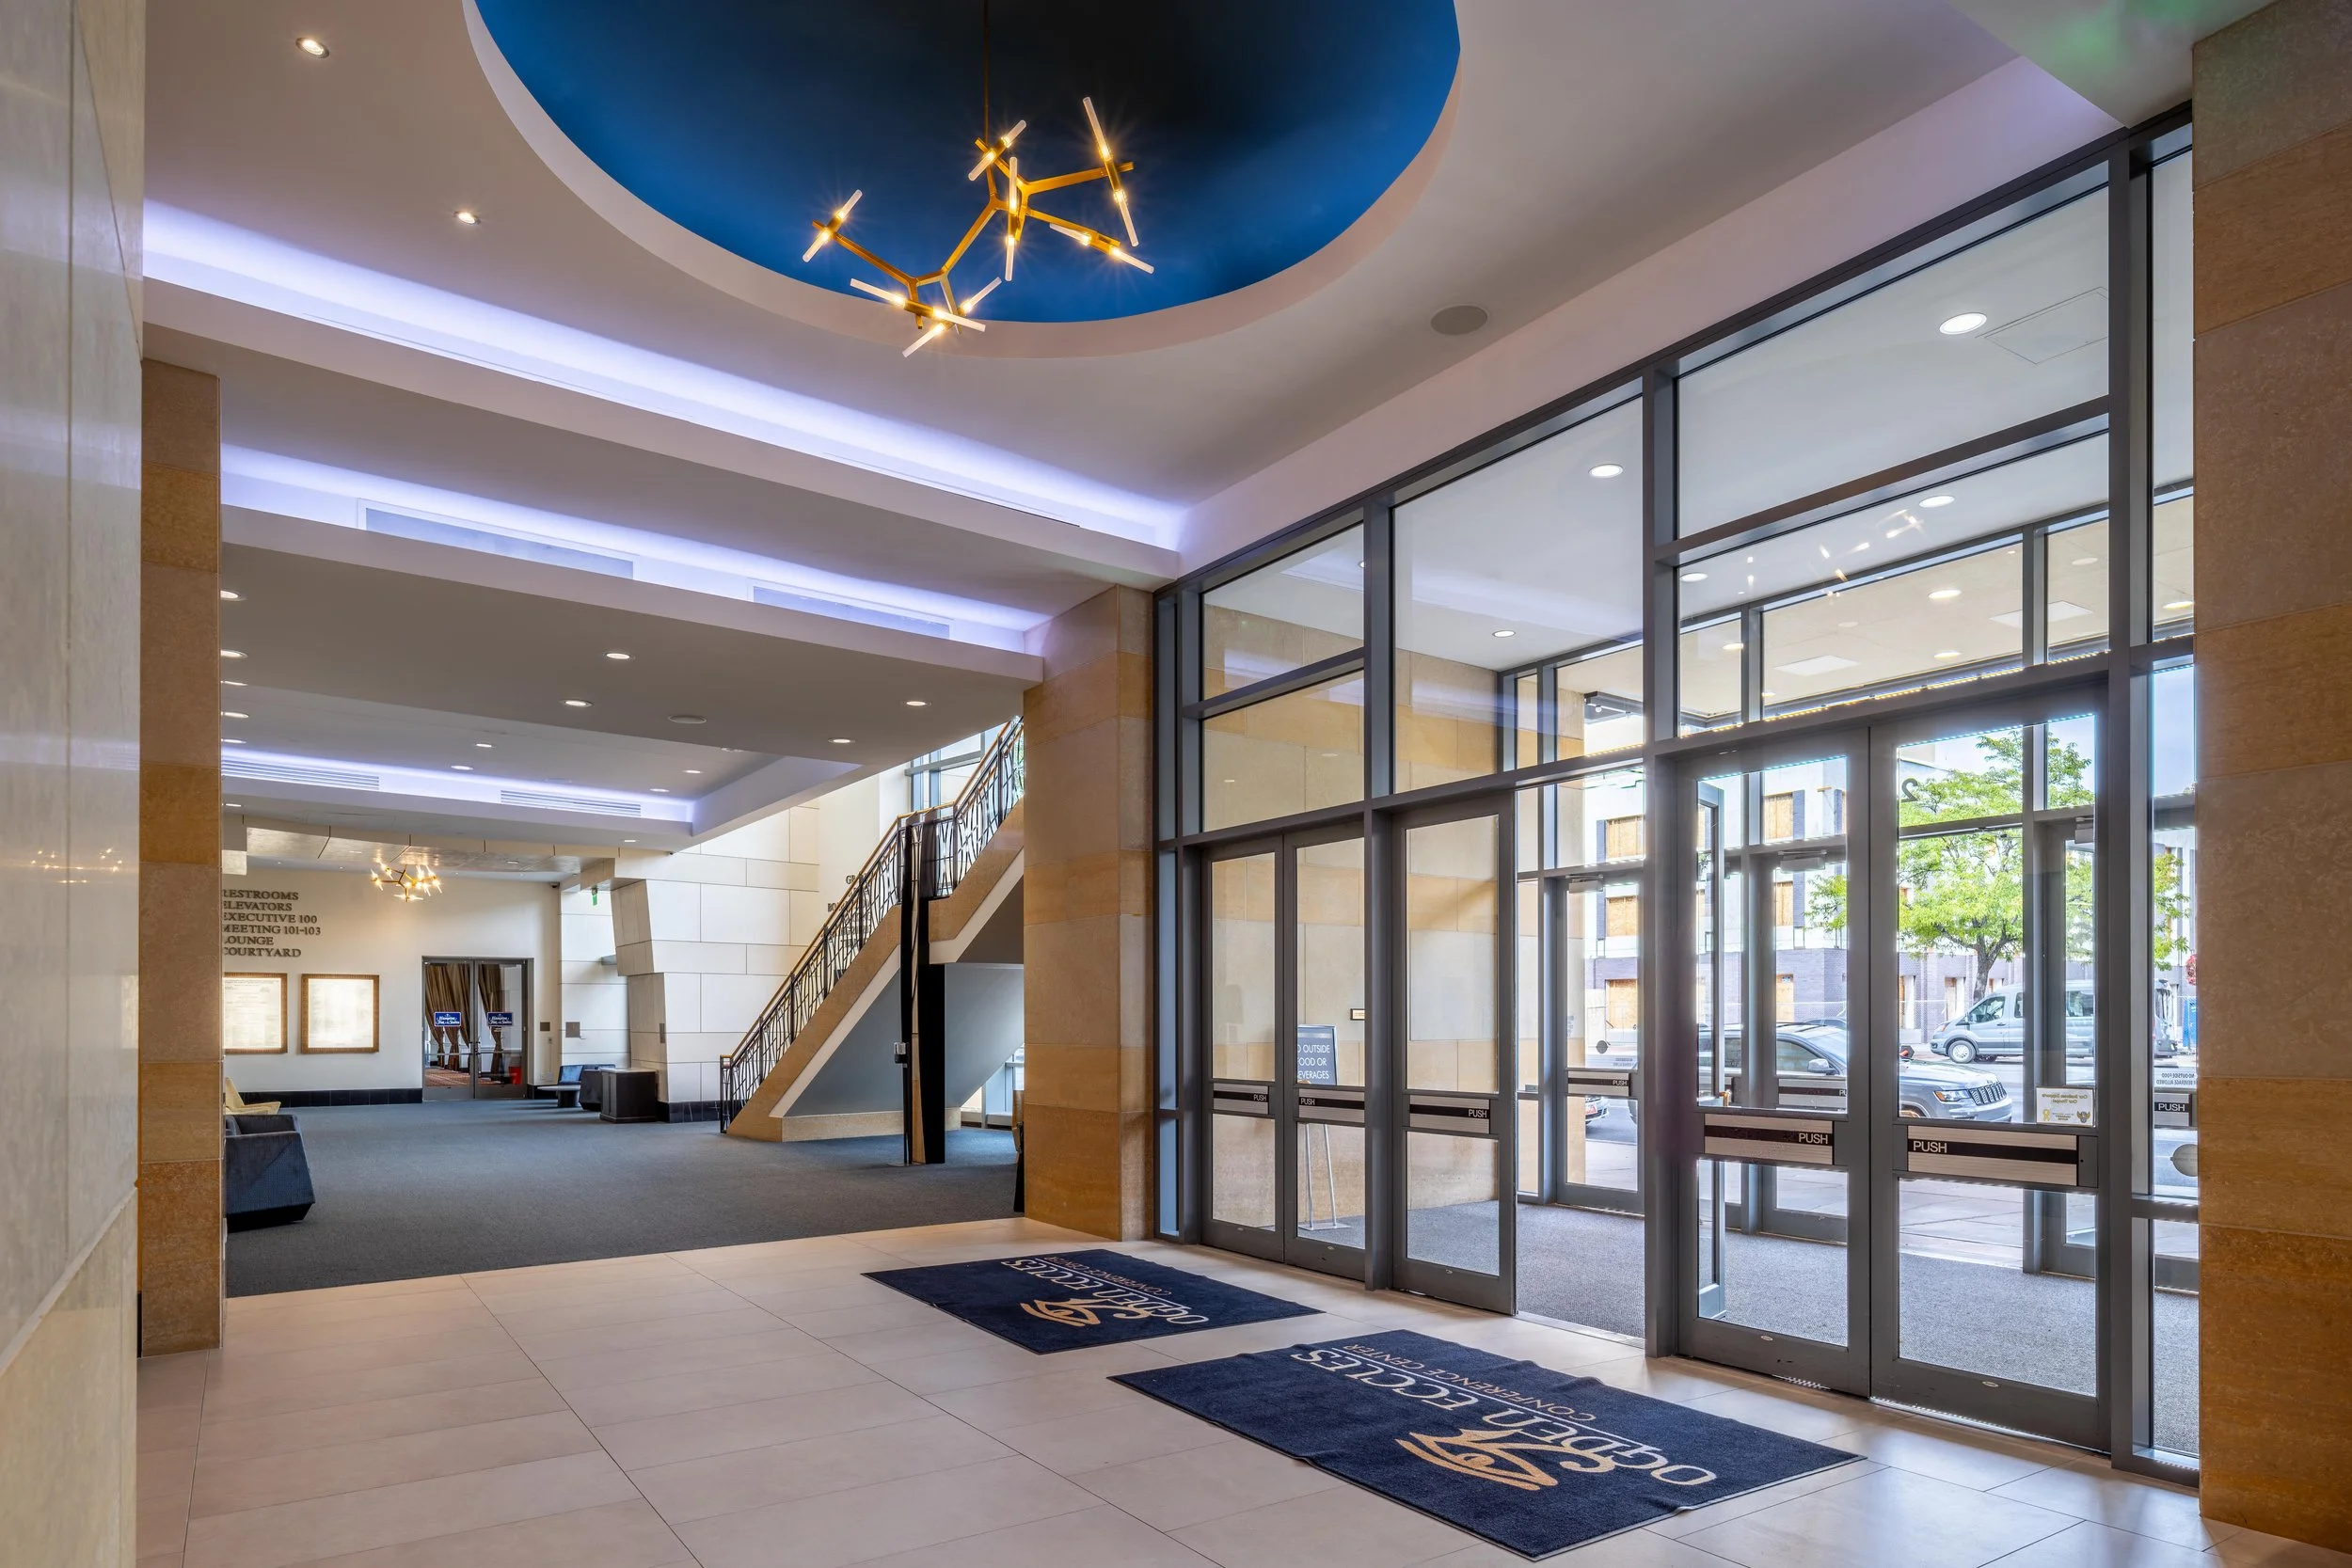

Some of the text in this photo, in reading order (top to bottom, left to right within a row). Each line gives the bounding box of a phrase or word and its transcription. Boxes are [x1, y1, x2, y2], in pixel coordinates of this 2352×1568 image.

[299, 915, 318, 924] 100
[284, 926, 321, 935] 101-103
[224, 935, 274, 945] OUNGE
[1303, 1044, 1330, 1053] OUTSIDE
[1297, 1057, 1327, 1067] OOD OR
[1298, 1070, 1329, 1079] EVERAGES
[1253, 1093, 1267, 1101] PUSH
[1300, 1097, 1315, 1105] PUSH
[2157, 1103, 2185, 1112] PUSH
[1468, 1109, 1487, 1118] PUSH
[1798, 1132, 1829, 1145] PUSH
[1913, 1140, 1947, 1153] PUSH
[1089, 1269, 1172, 1295] CONFERENCE
[1001, 1259, 1210, 1324] OGDEN ECCLES
[1343, 1343, 1597, 1421] CONFERENCE CENTER
[1290, 1349, 1718, 1486] OGDEN ECCLES
